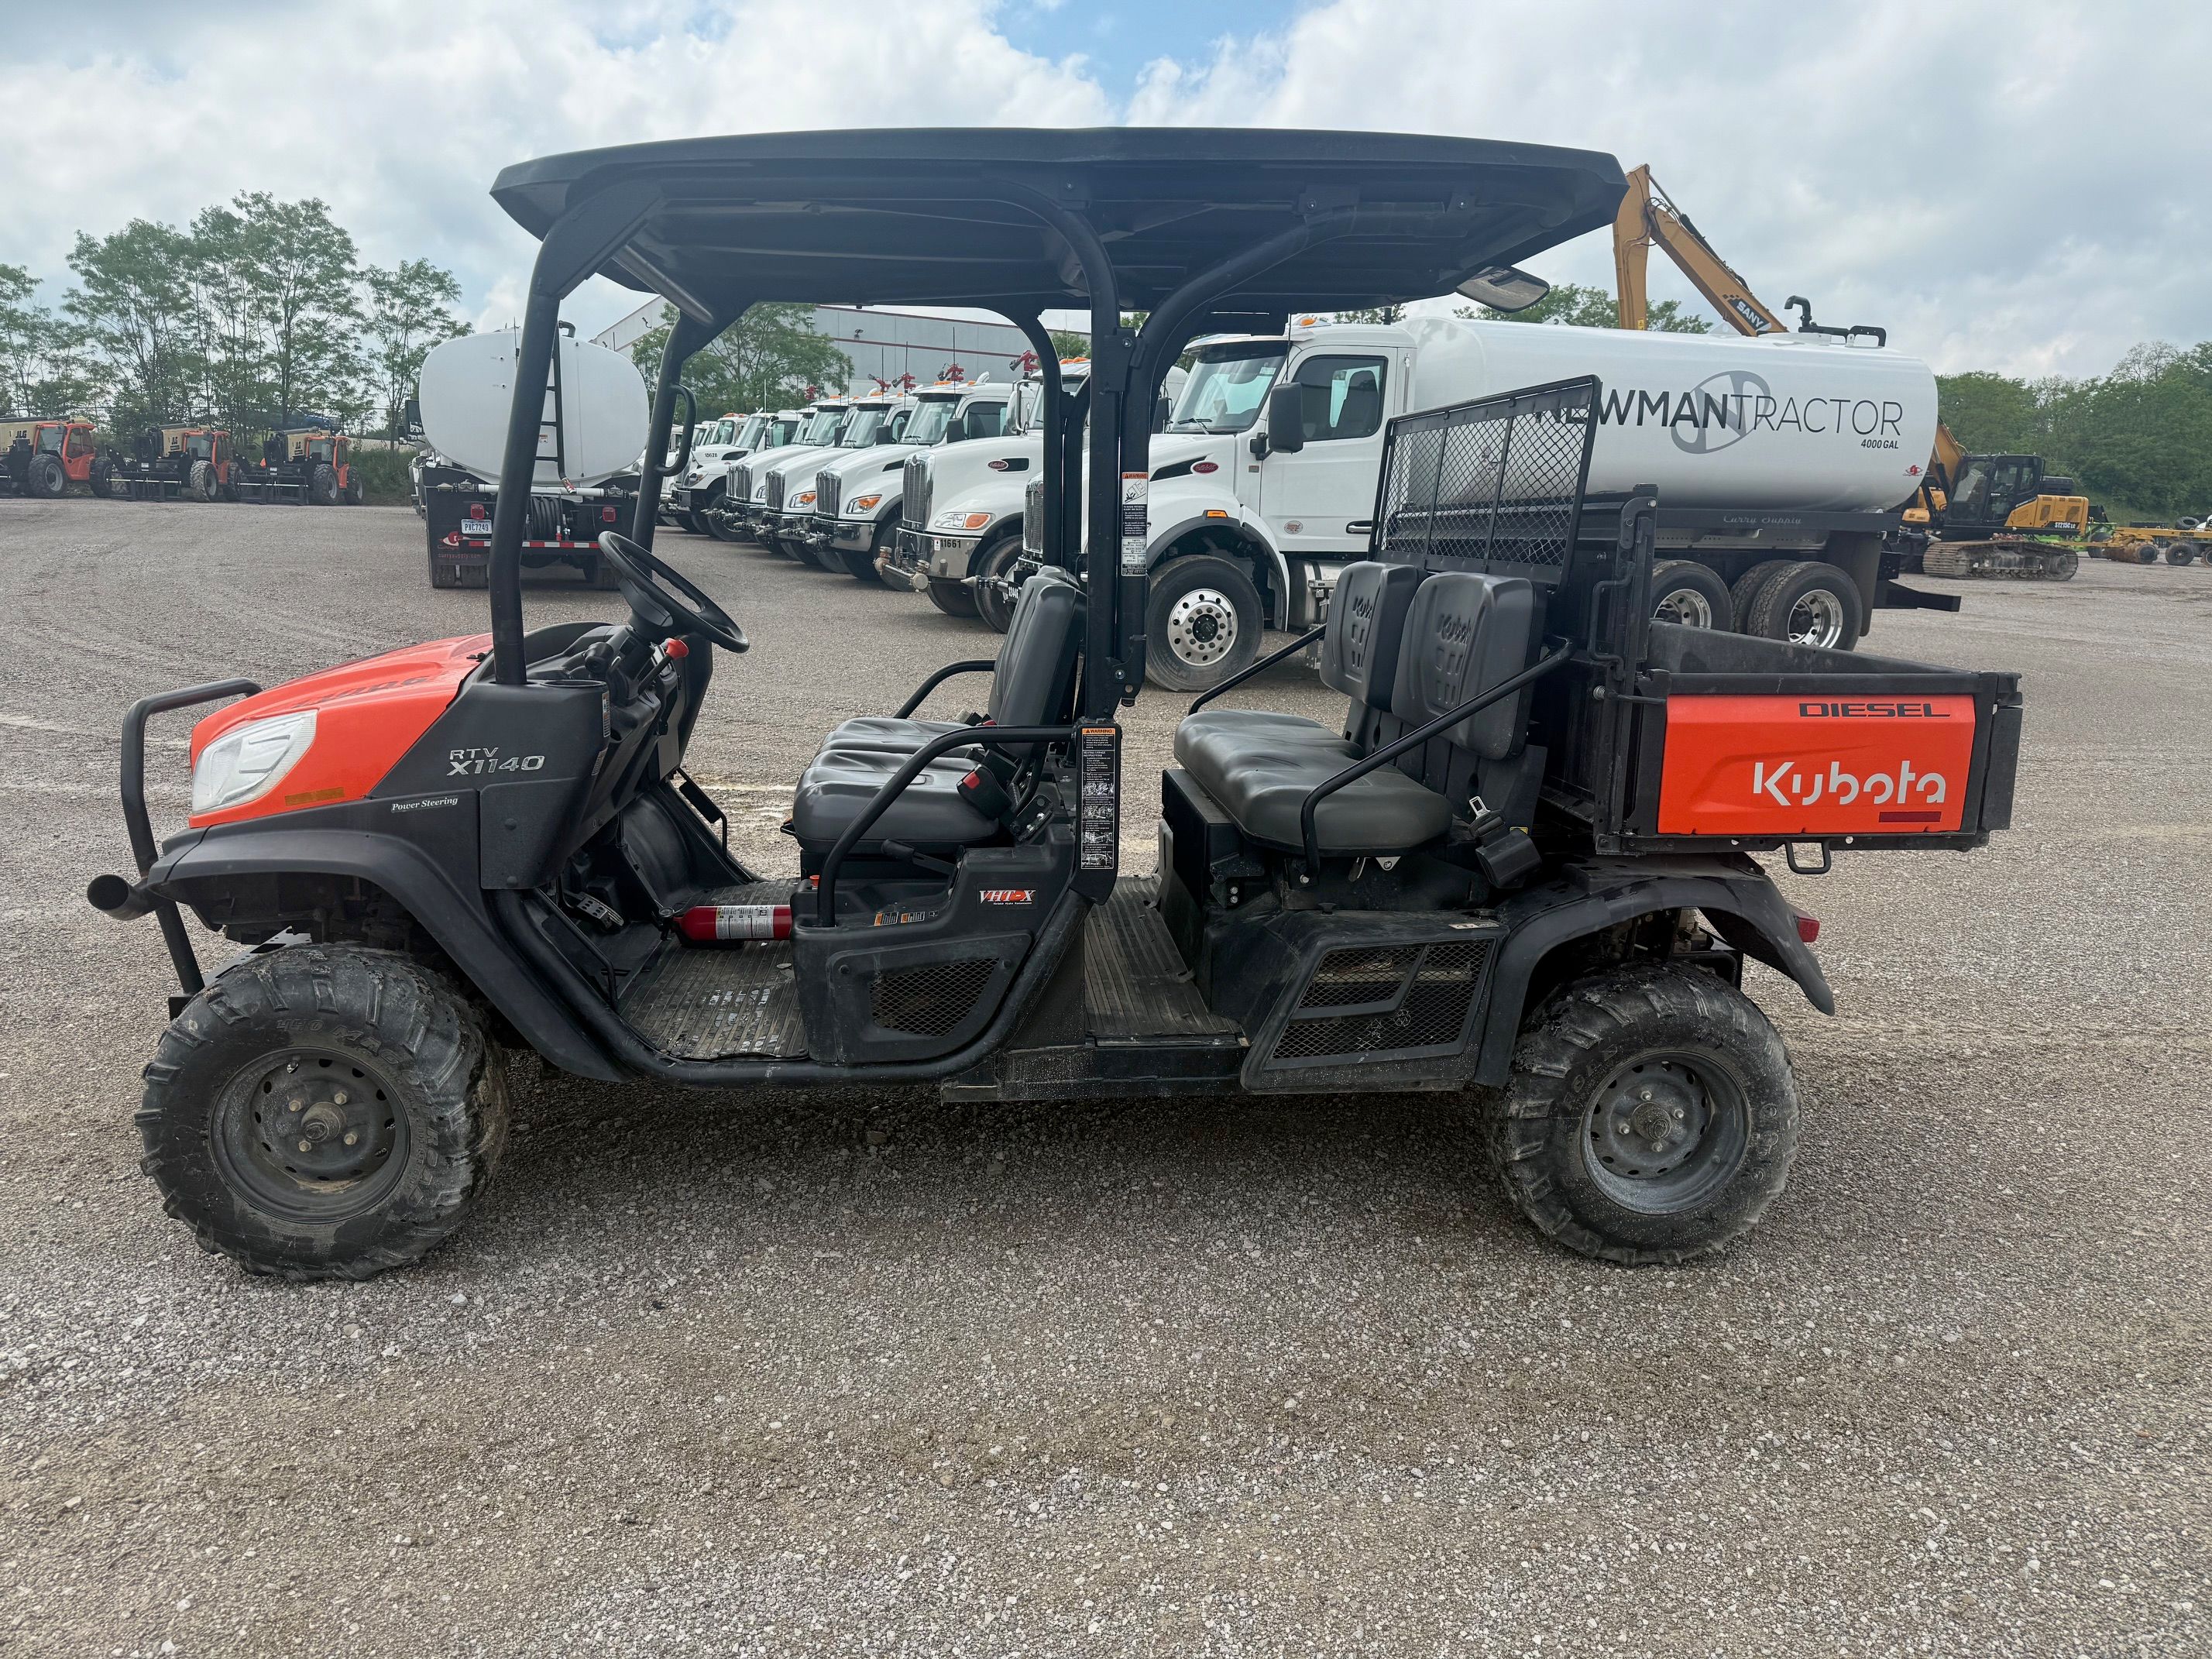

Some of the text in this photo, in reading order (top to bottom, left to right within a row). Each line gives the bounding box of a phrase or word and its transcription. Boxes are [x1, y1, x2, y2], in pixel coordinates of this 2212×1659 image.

[1736, 301, 1764, 328] SANY
[1860, 438, 1899, 449] 4000 GAL
[940, 538, 961, 548] 11661
[1798, 702, 1951, 718] DIESEL
[449, 747, 499, 761] RTV
[447, 755, 545, 776] X1140
[1753, 760, 1946, 806] Kubota
[392, 796, 459, 812] Power Steering
[979, 890, 1036, 904] VHT-X
